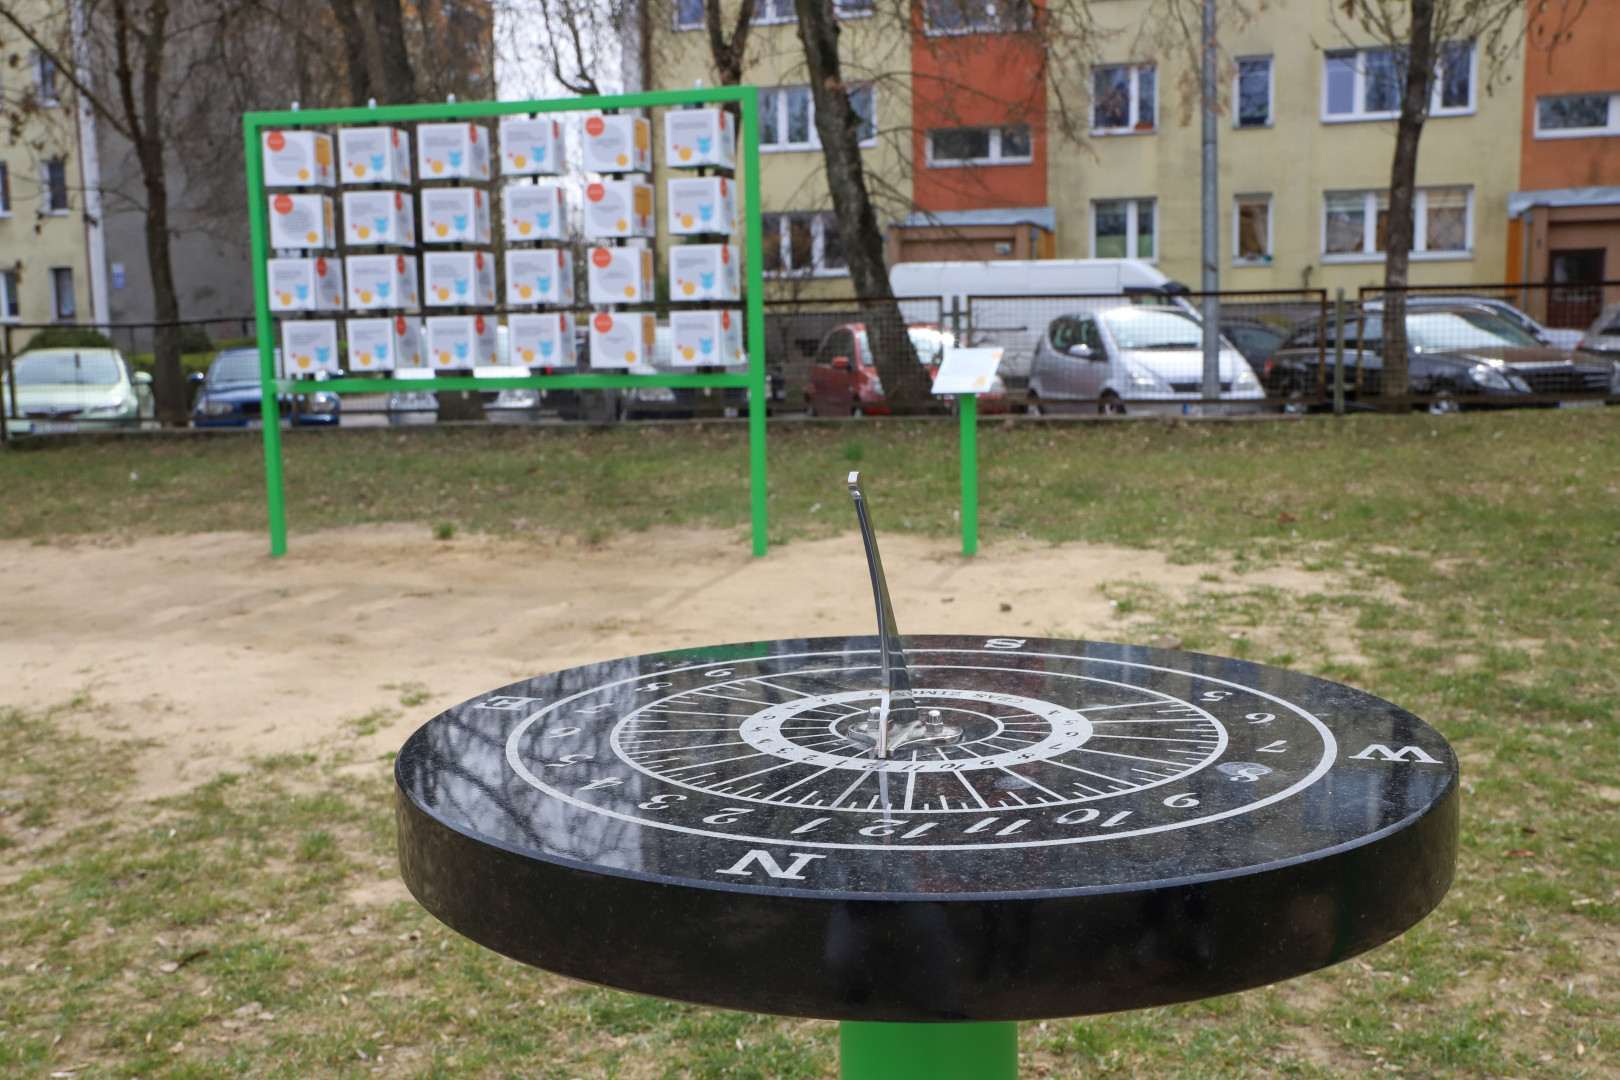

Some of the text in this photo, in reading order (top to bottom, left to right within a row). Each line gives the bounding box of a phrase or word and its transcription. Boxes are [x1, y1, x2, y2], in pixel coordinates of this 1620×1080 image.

[984, 638, 1026, 649] S
[473, 695, 543, 711] E
[1245, 712, 1276, 724] 6
[1256, 740, 1288, 753] 7
[1348, 743, 1444, 764] W
[544, 753, 594, 768] 5
[1229, 767, 1272, 782] 8
[577, 776, 624, 791] 4
[637, 794, 688, 810] 3
[1163, 792, 1200, 808] 9
[702, 807, 755, 825] 2
[1055, 808, 1133, 827] 10
[790, 817, 832, 834] 1
[858, 818, 939, 839] 12
[962, 817, 1032, 836] 11
[715, 849, 828, 880] N
